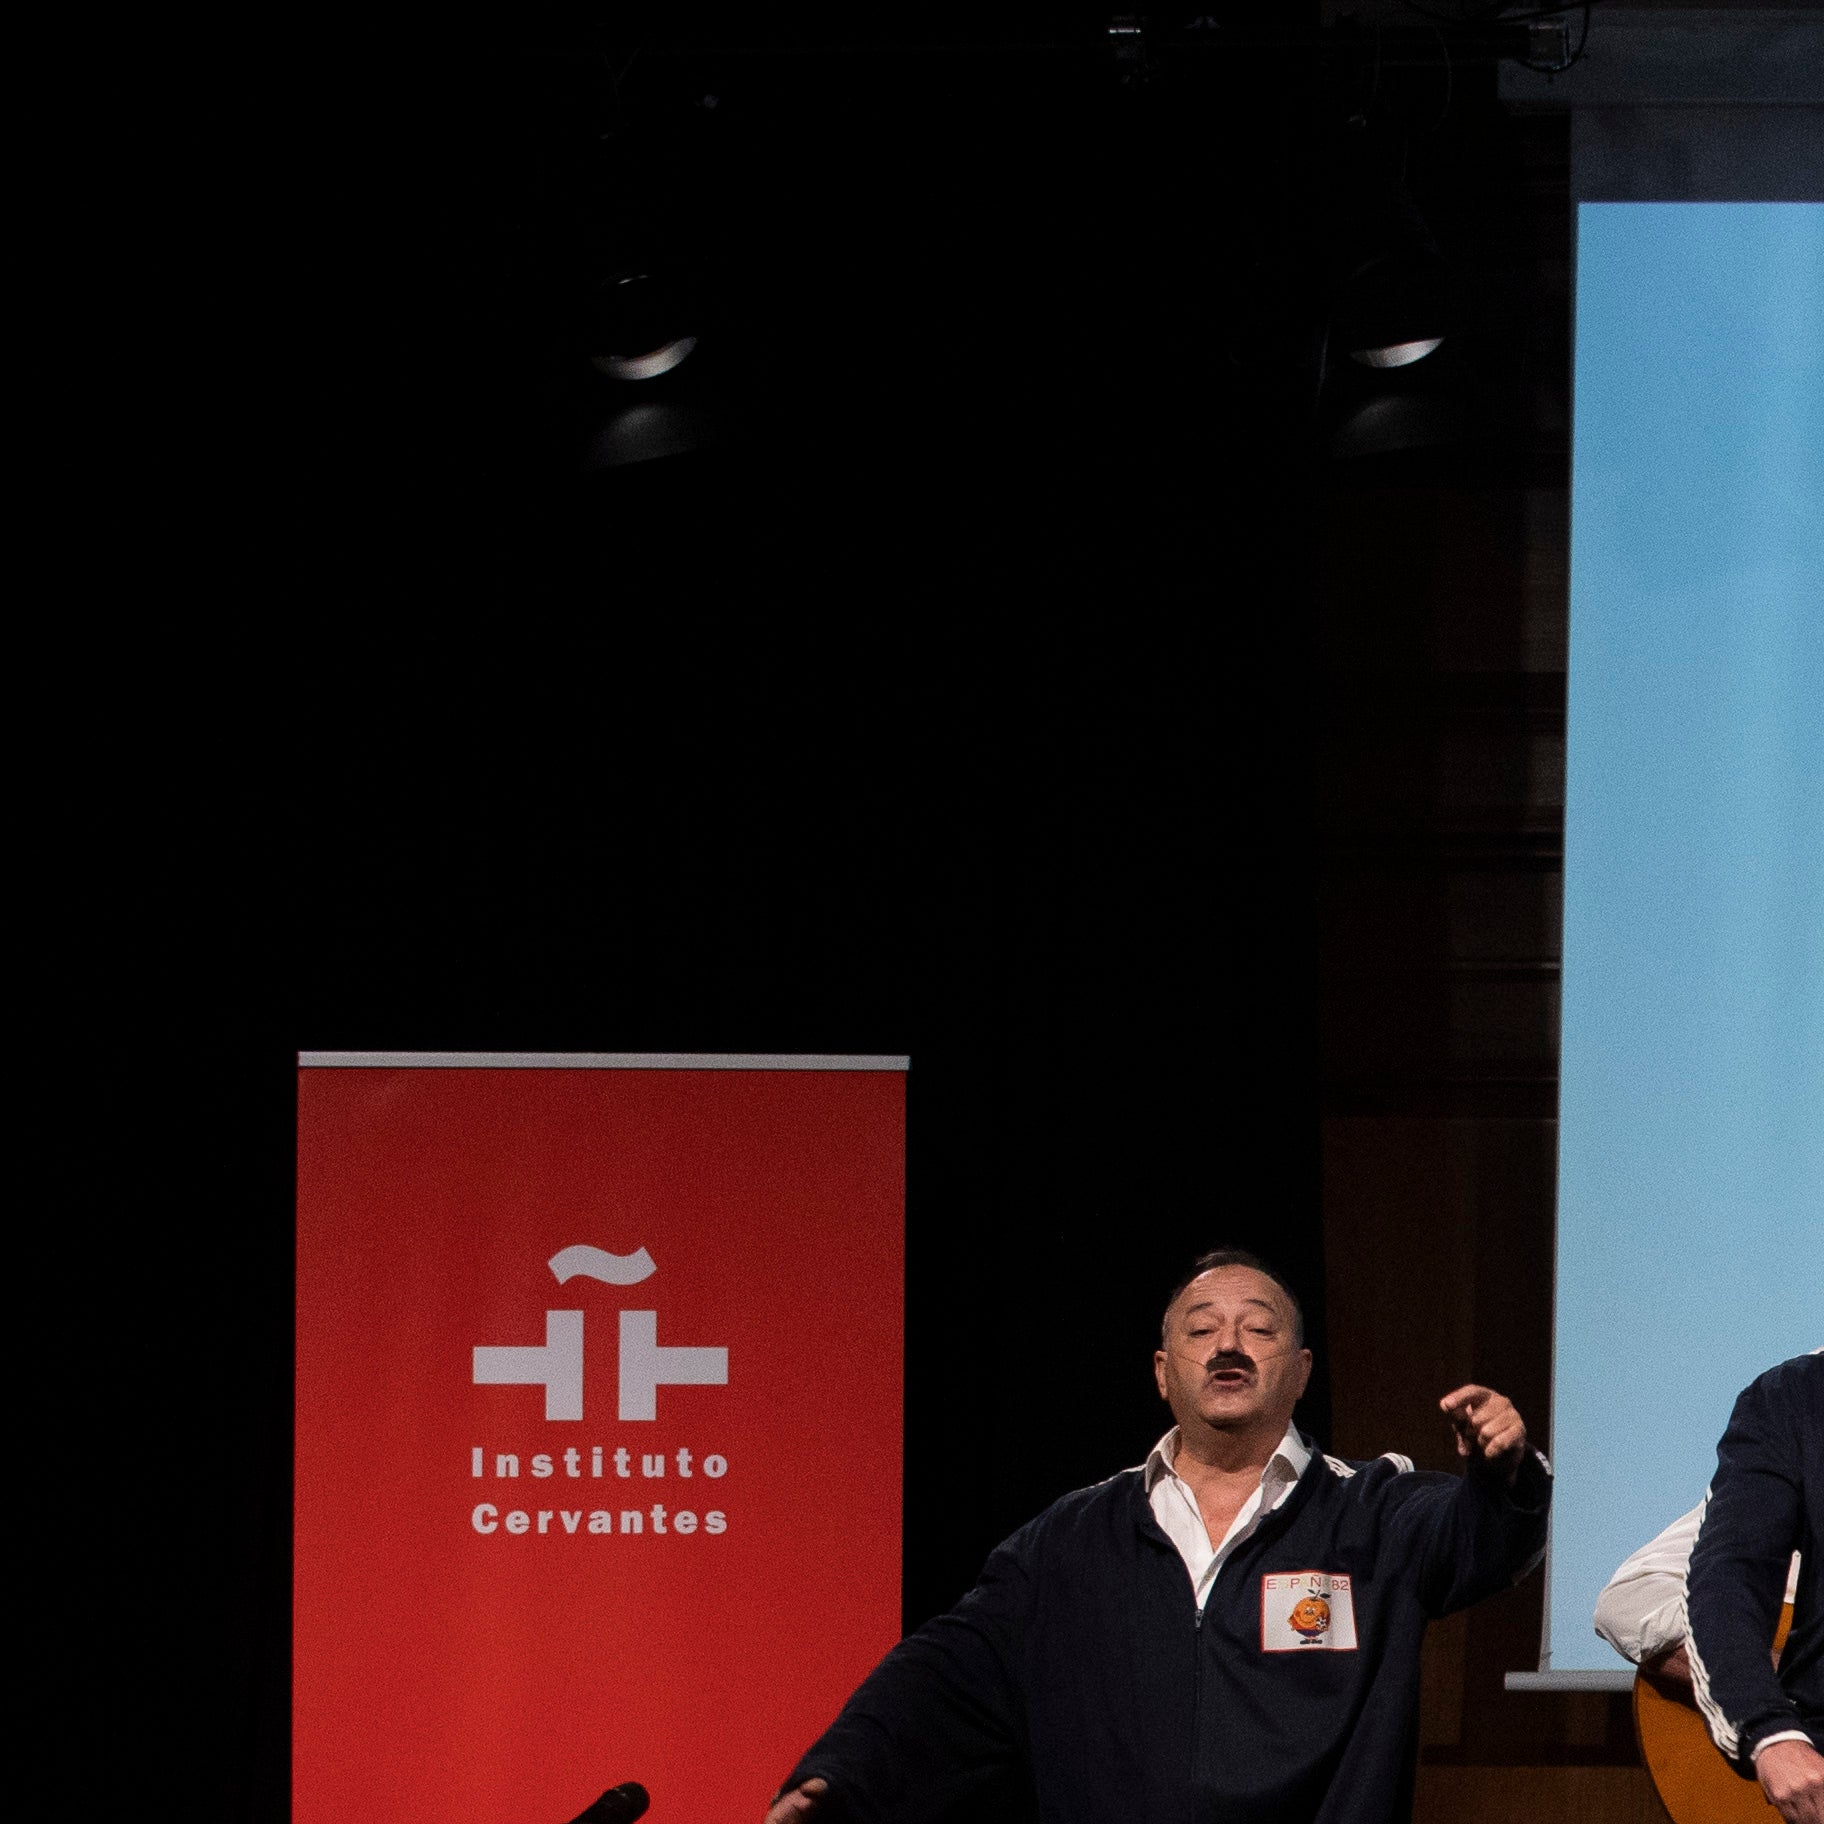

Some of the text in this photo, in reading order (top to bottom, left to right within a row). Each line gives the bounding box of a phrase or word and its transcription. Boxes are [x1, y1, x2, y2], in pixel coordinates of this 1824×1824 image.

[471, 1446, 728, 1479] Instituto
[471, 1503, 728, 1535] Cervantes
[1331, 1579, 1350, 1591] 82
